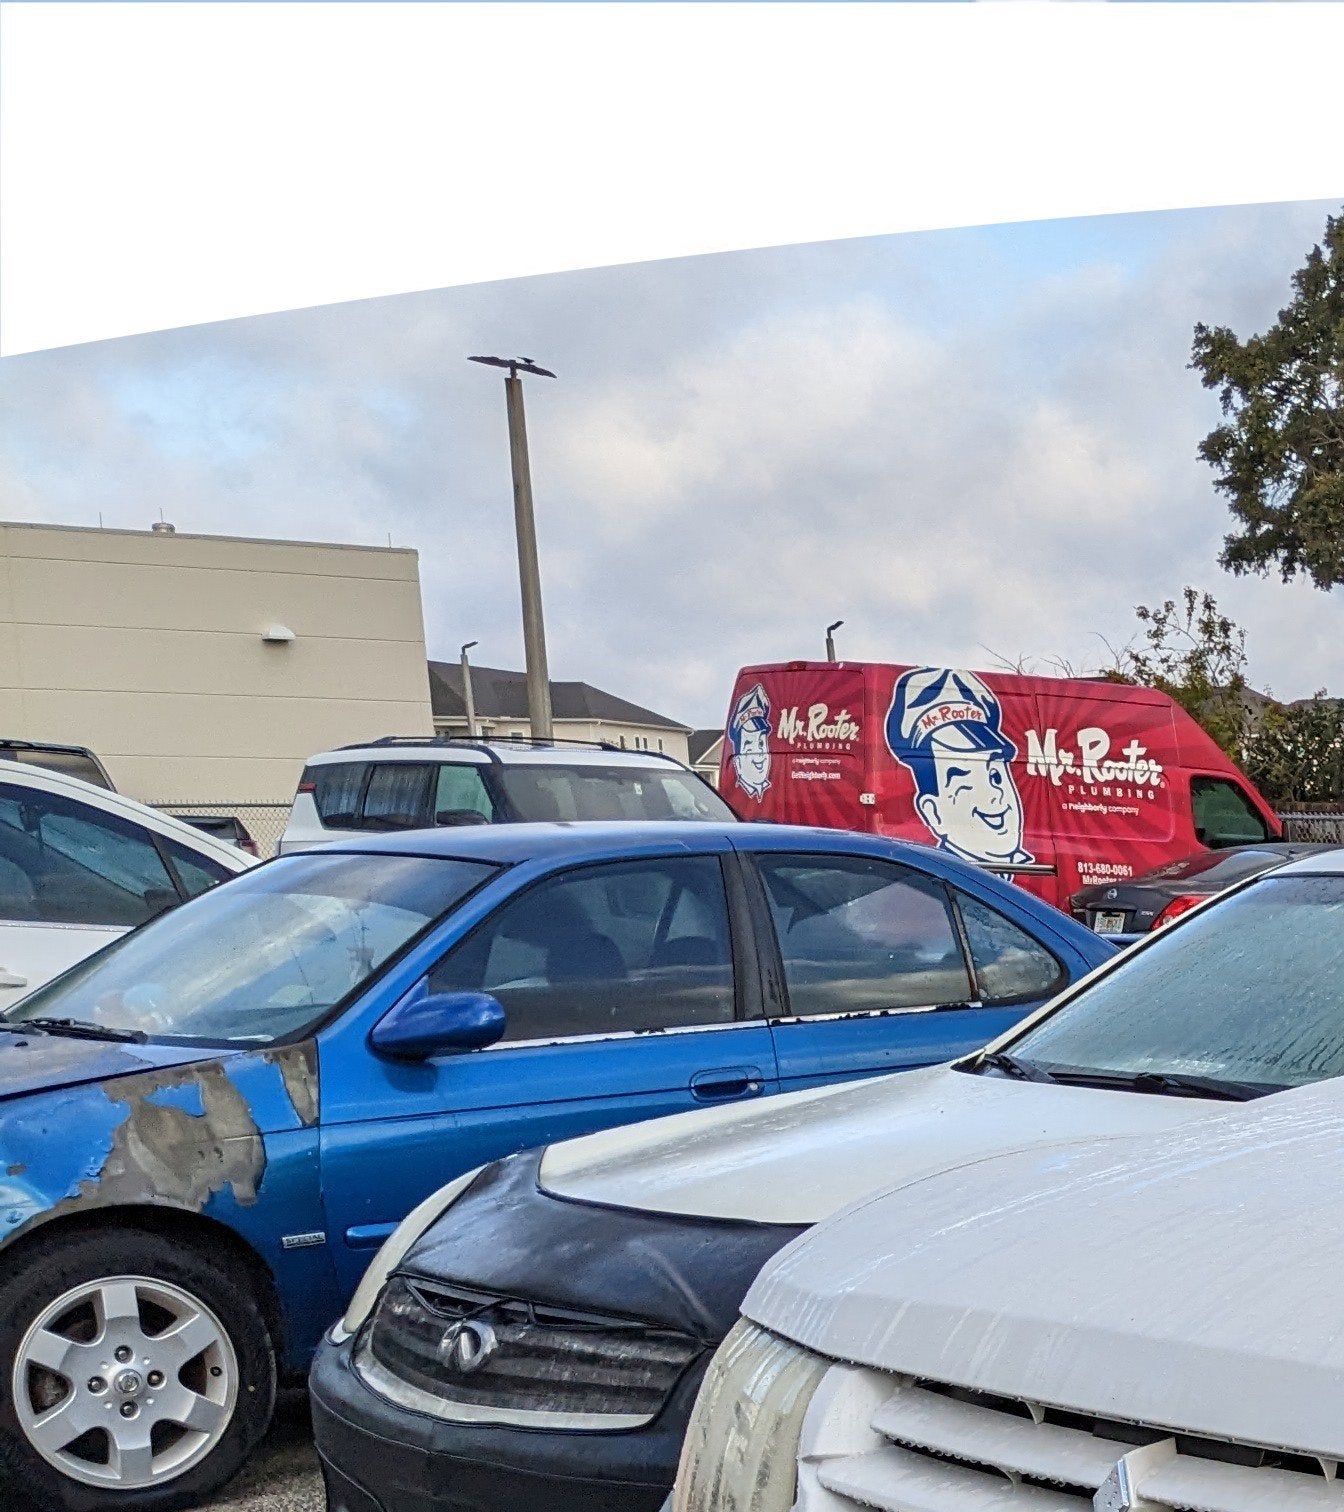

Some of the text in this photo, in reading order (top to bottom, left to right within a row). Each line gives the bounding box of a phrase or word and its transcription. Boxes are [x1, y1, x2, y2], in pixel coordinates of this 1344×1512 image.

[777, 706, 806, 744] Mr.
[807, 703, 859, 741] Rooter
[938, 706, 982, 721] Rooter
[1024, 727, 1163, 786] Mr. Rooter
[1068, 784, 1155, 800] PLUMBING
